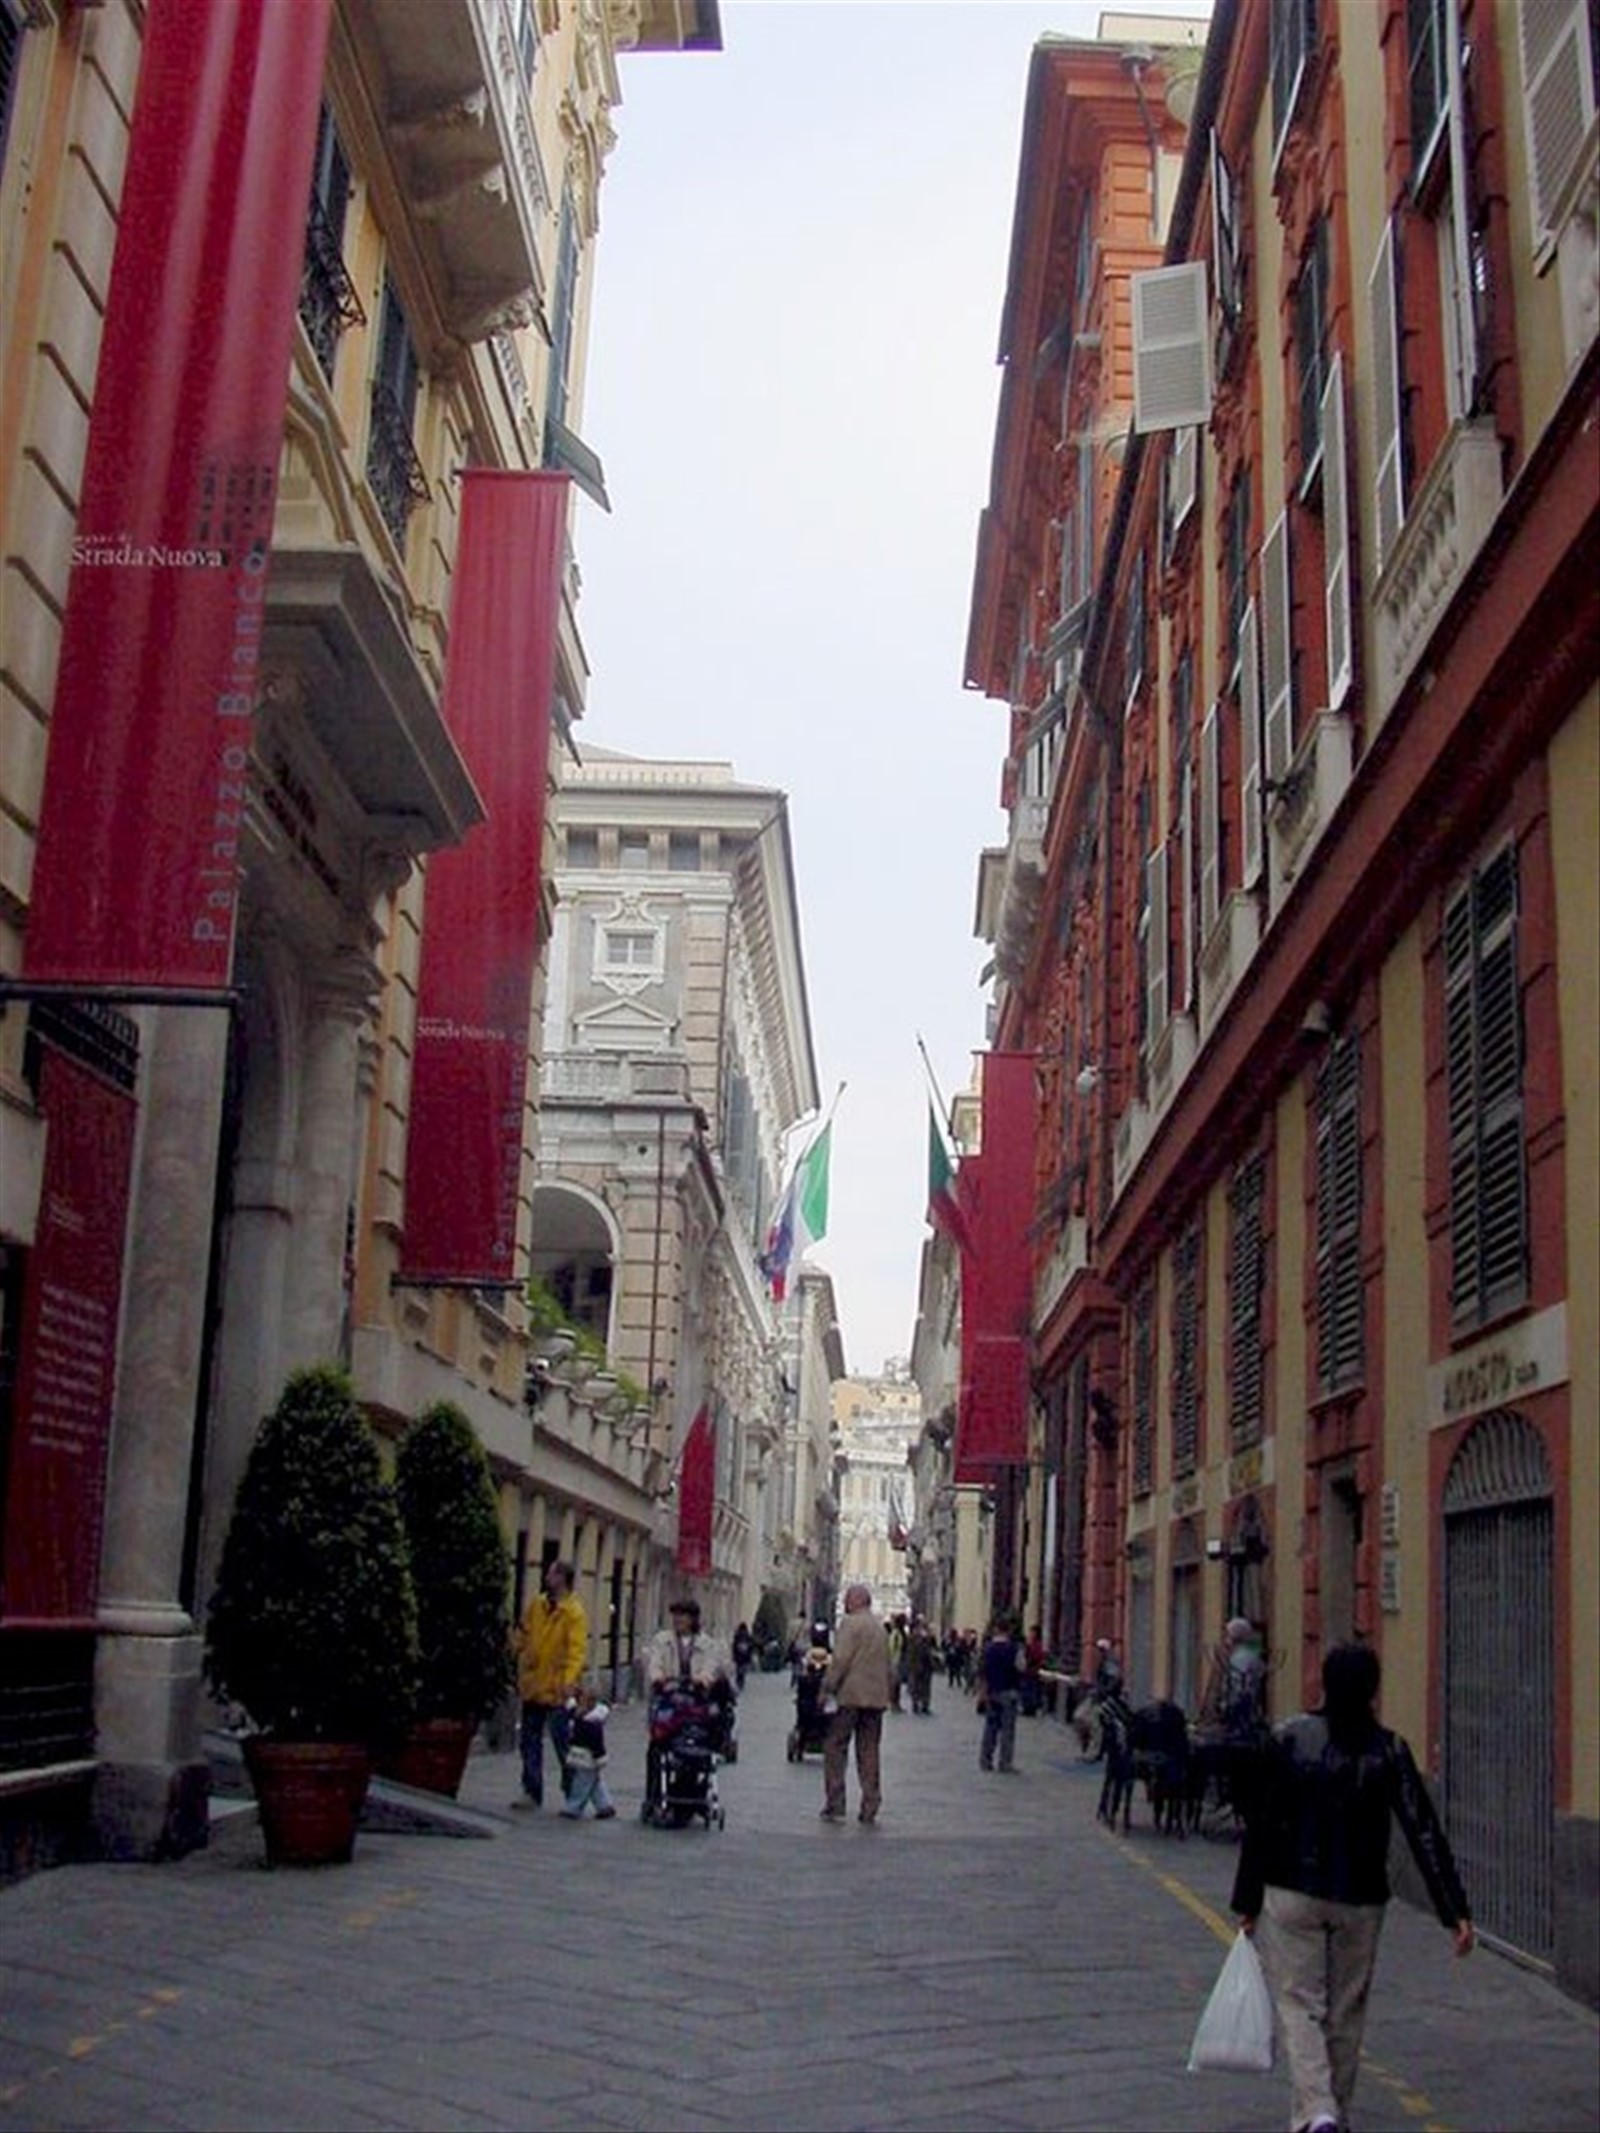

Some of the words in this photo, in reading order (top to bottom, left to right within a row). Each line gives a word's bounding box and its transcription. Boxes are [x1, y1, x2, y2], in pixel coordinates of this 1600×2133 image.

[72, 543, 143, 567] Strada
[148, 545, 224, 567] Nuova
[216, 551, 266, 715] Bianco
[191, 747, 247, 940] Palazzo
